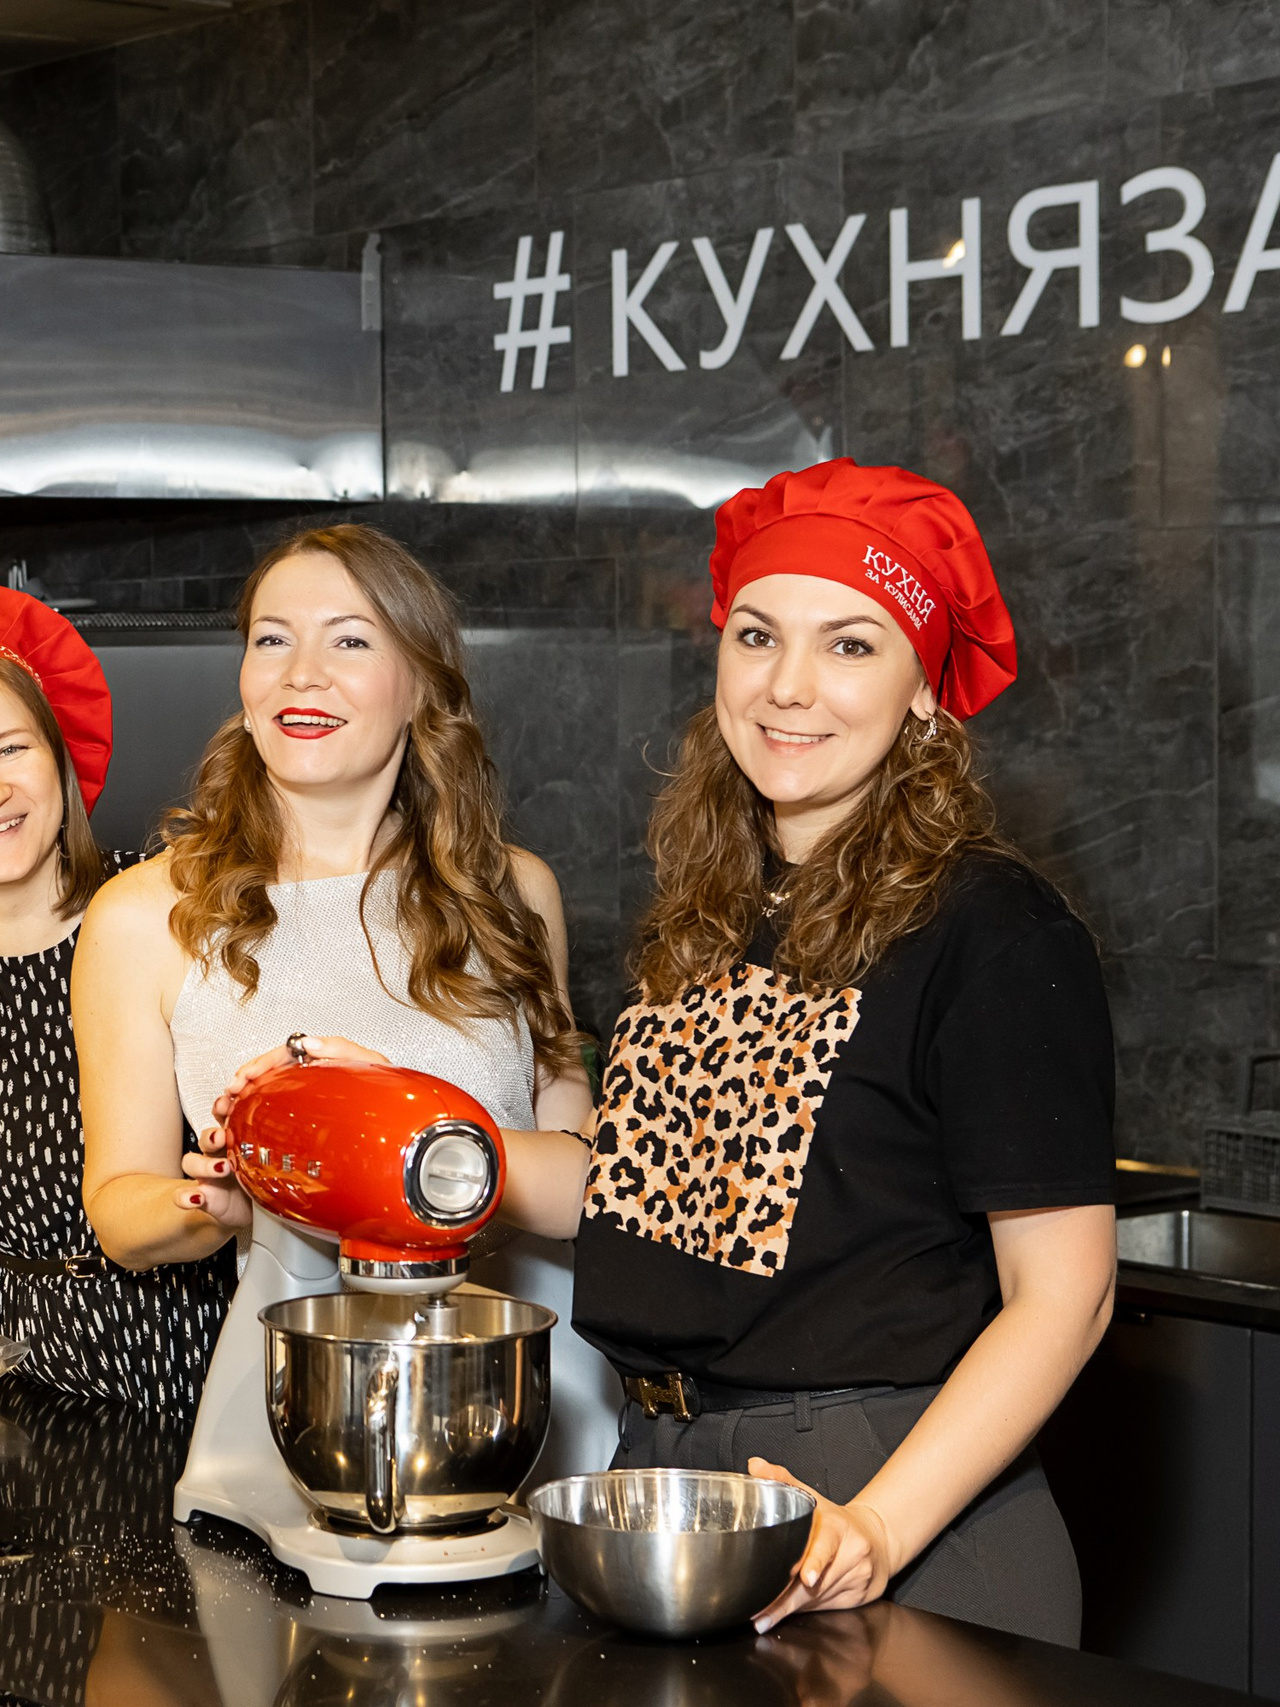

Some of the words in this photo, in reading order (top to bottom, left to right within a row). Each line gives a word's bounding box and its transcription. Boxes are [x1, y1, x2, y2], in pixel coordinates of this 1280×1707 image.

[862, 545, 936, 624] КУХНЯ
[865, 569, 880, 585] ЗА
[884, 581, 922, 631] КУЛИСАМИ
